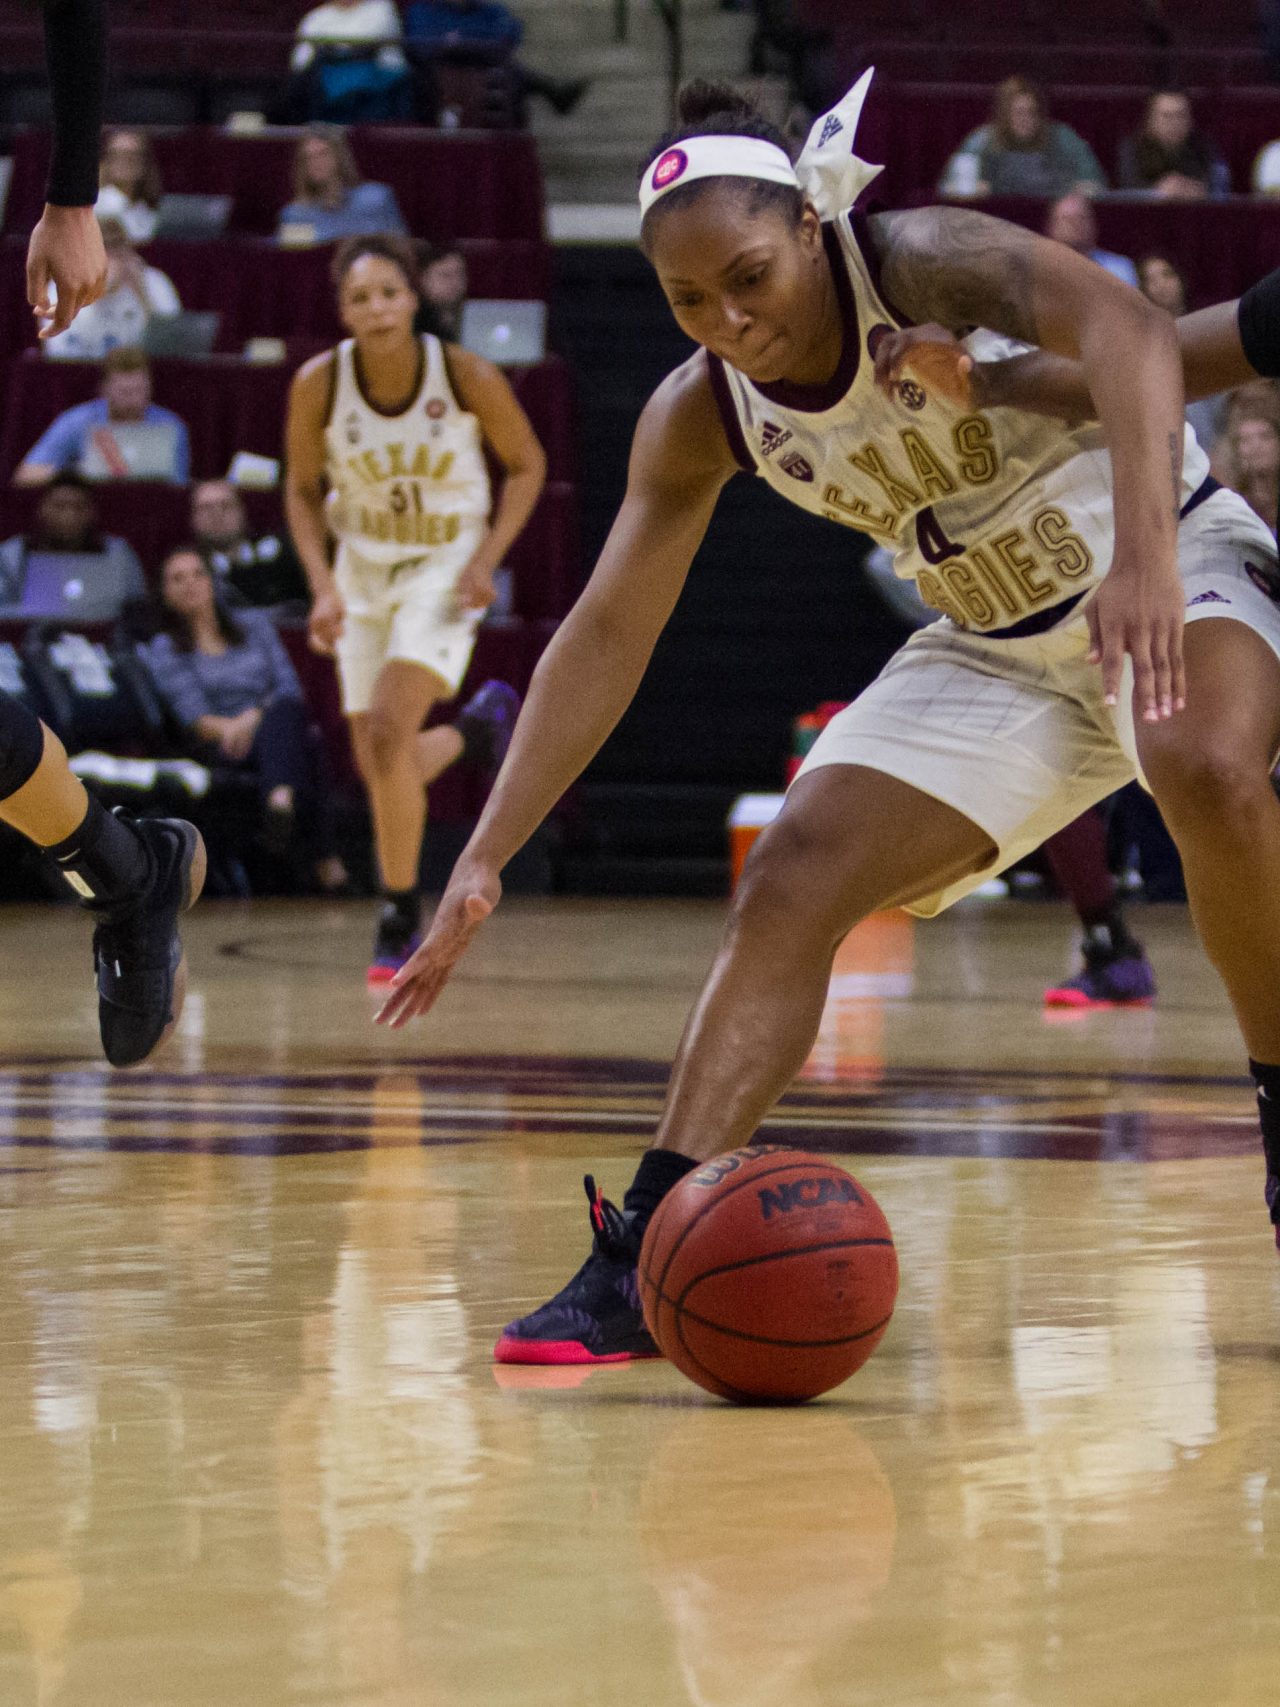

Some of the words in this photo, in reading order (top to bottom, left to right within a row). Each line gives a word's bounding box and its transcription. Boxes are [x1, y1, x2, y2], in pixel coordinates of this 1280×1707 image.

[762, 430, 793, 456] adidas
[915, 505, 966, 565] 4
[758, 1177, 864, 1221] NCAA
